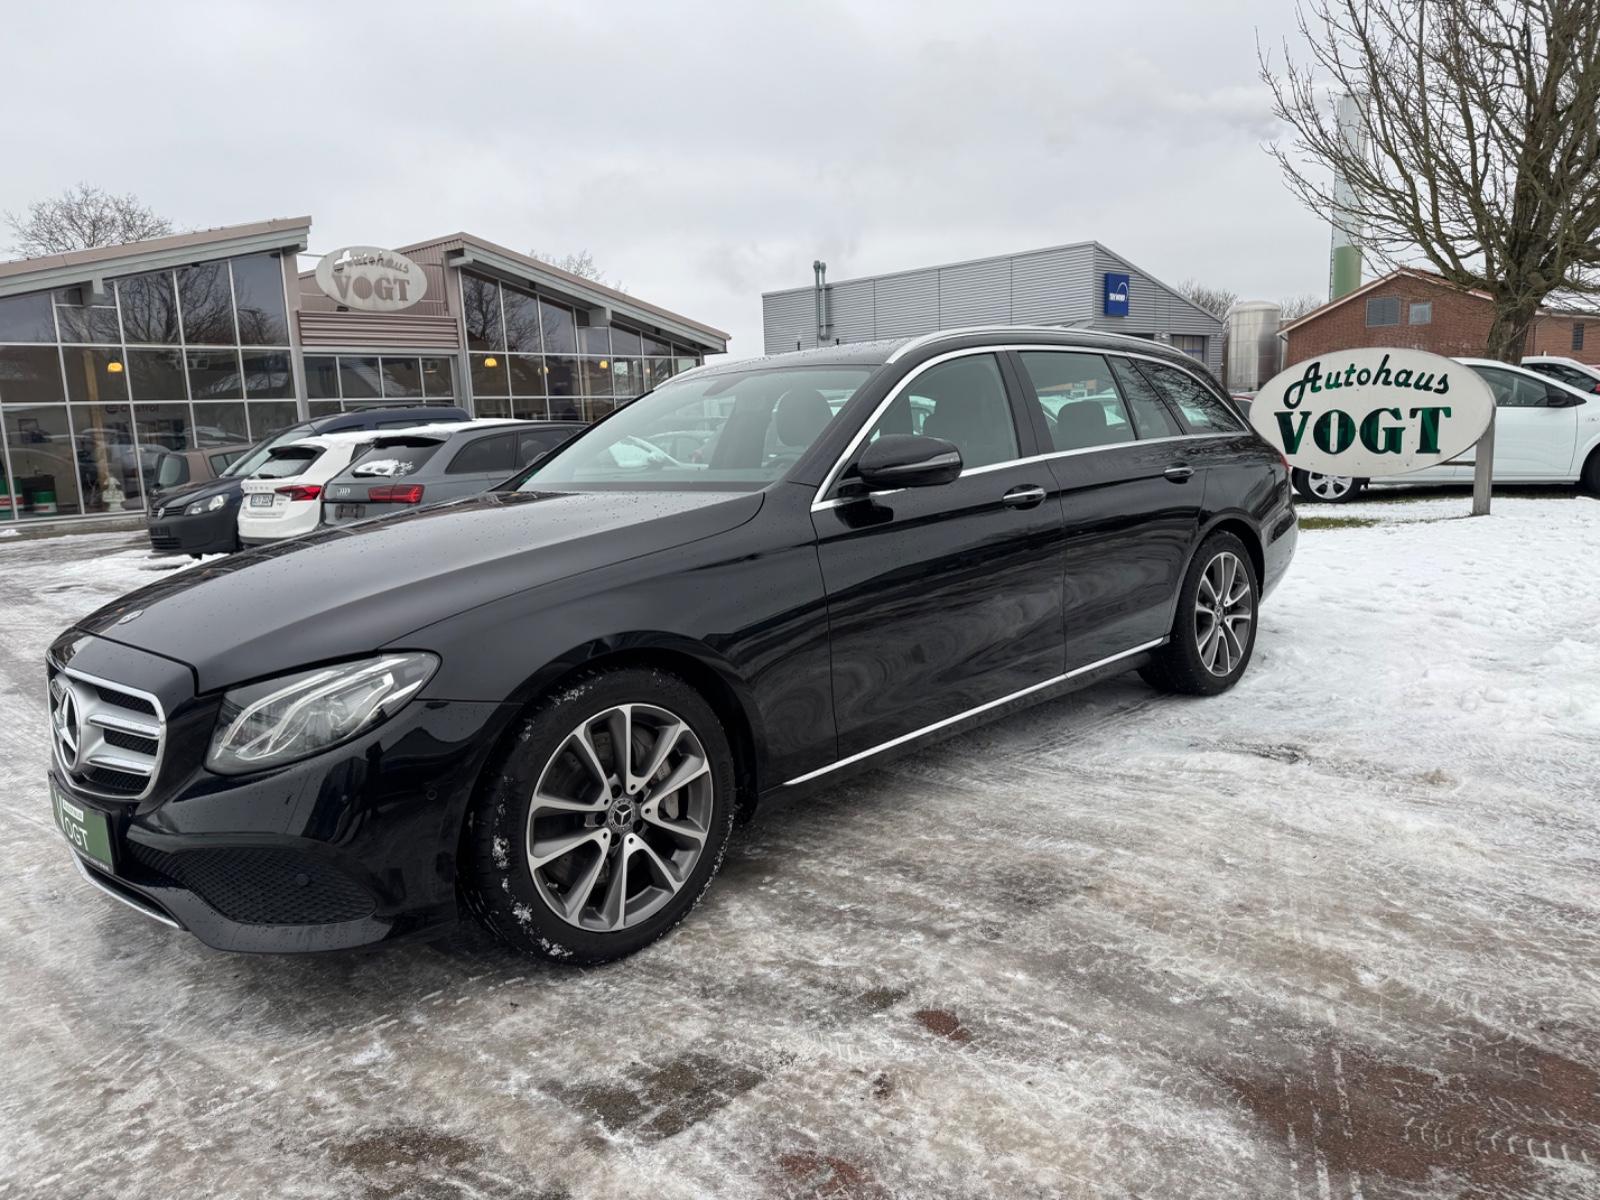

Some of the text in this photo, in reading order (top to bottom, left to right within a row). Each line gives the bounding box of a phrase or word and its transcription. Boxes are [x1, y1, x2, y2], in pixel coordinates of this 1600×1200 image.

[333, 249, 409, 273] Autohaus
[332, 274, 410, 301] VOGT
[1283, 354, 1449, 409] Autohaus
[1274, 407, 1451, 455] VOGT
